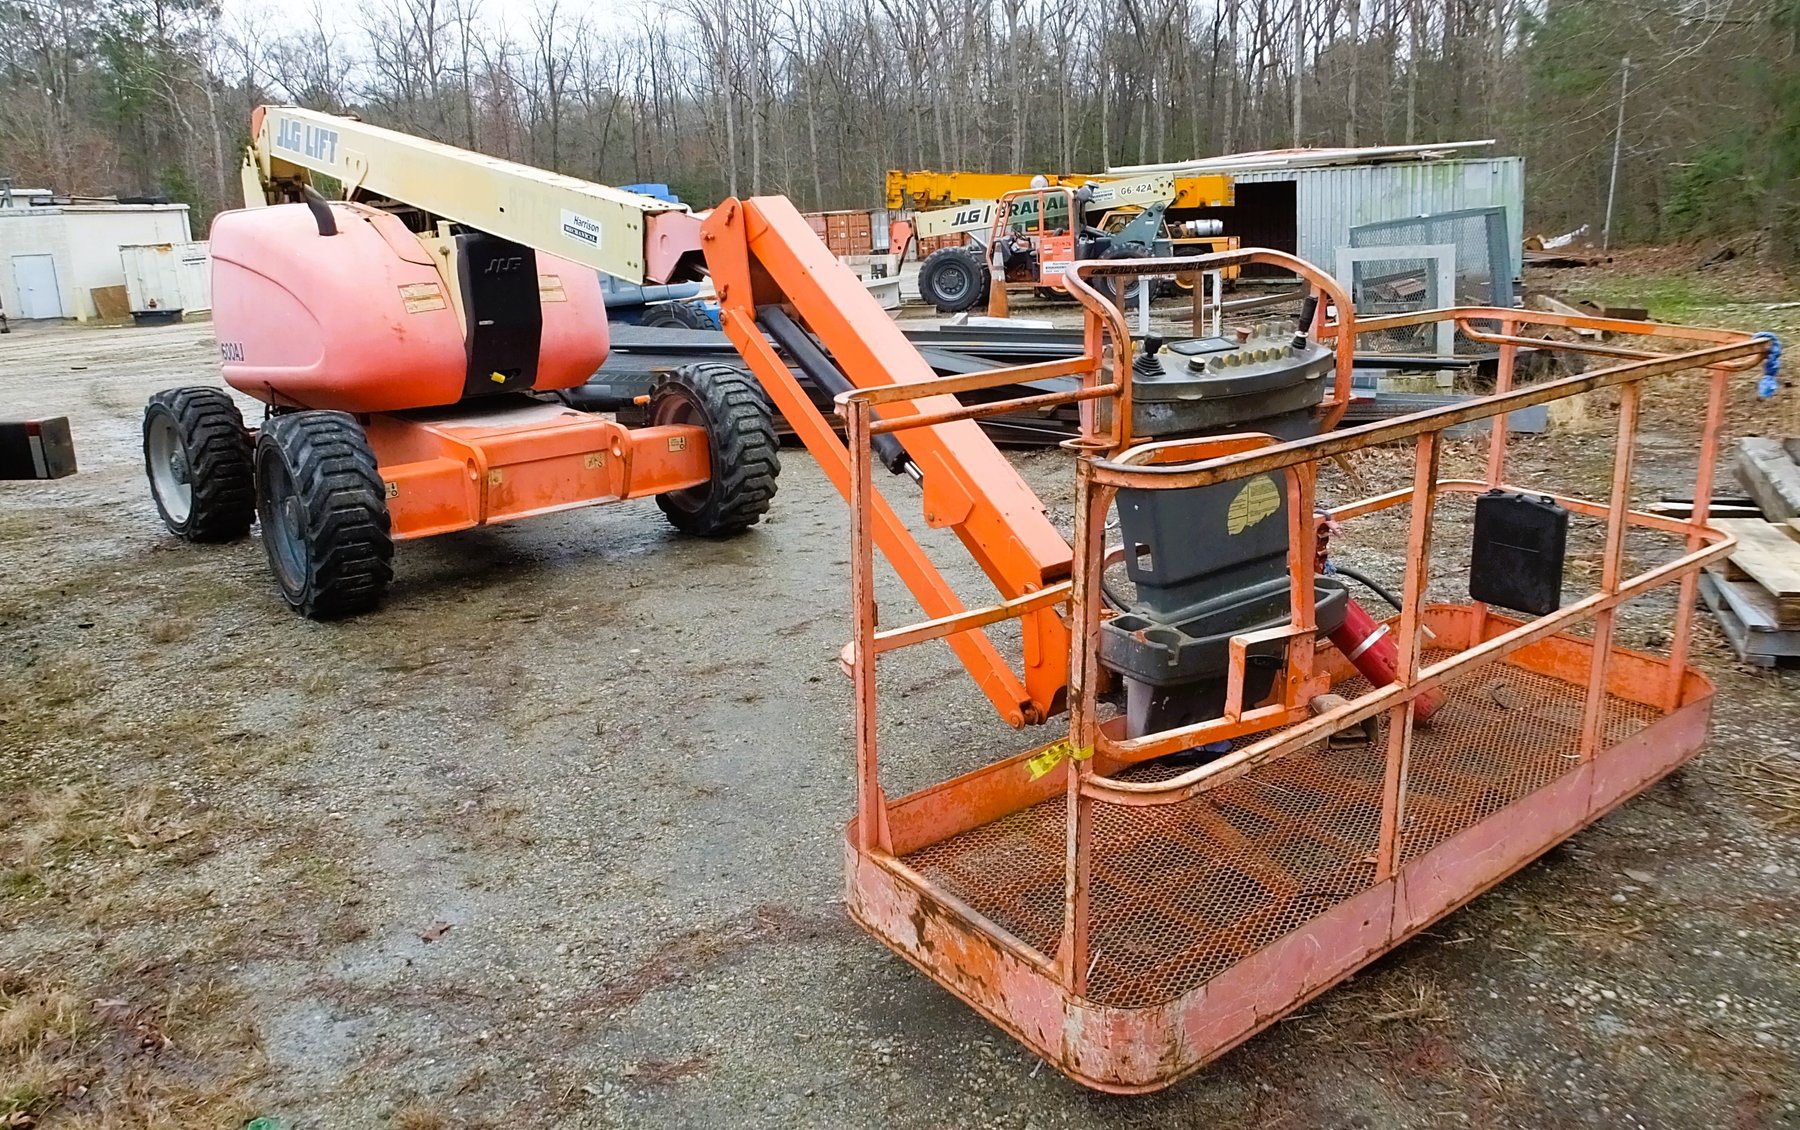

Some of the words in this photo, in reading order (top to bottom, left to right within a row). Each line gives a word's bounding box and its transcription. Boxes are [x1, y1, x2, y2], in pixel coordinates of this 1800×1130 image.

[276, 118, 301, 153] JLG
[304, 125, 339, 165] LIFT
[573, 215, 600, 233] Harrison
[951, 209, 981, 227] JLG
[994, 195, 1069, 219] GRADAL
